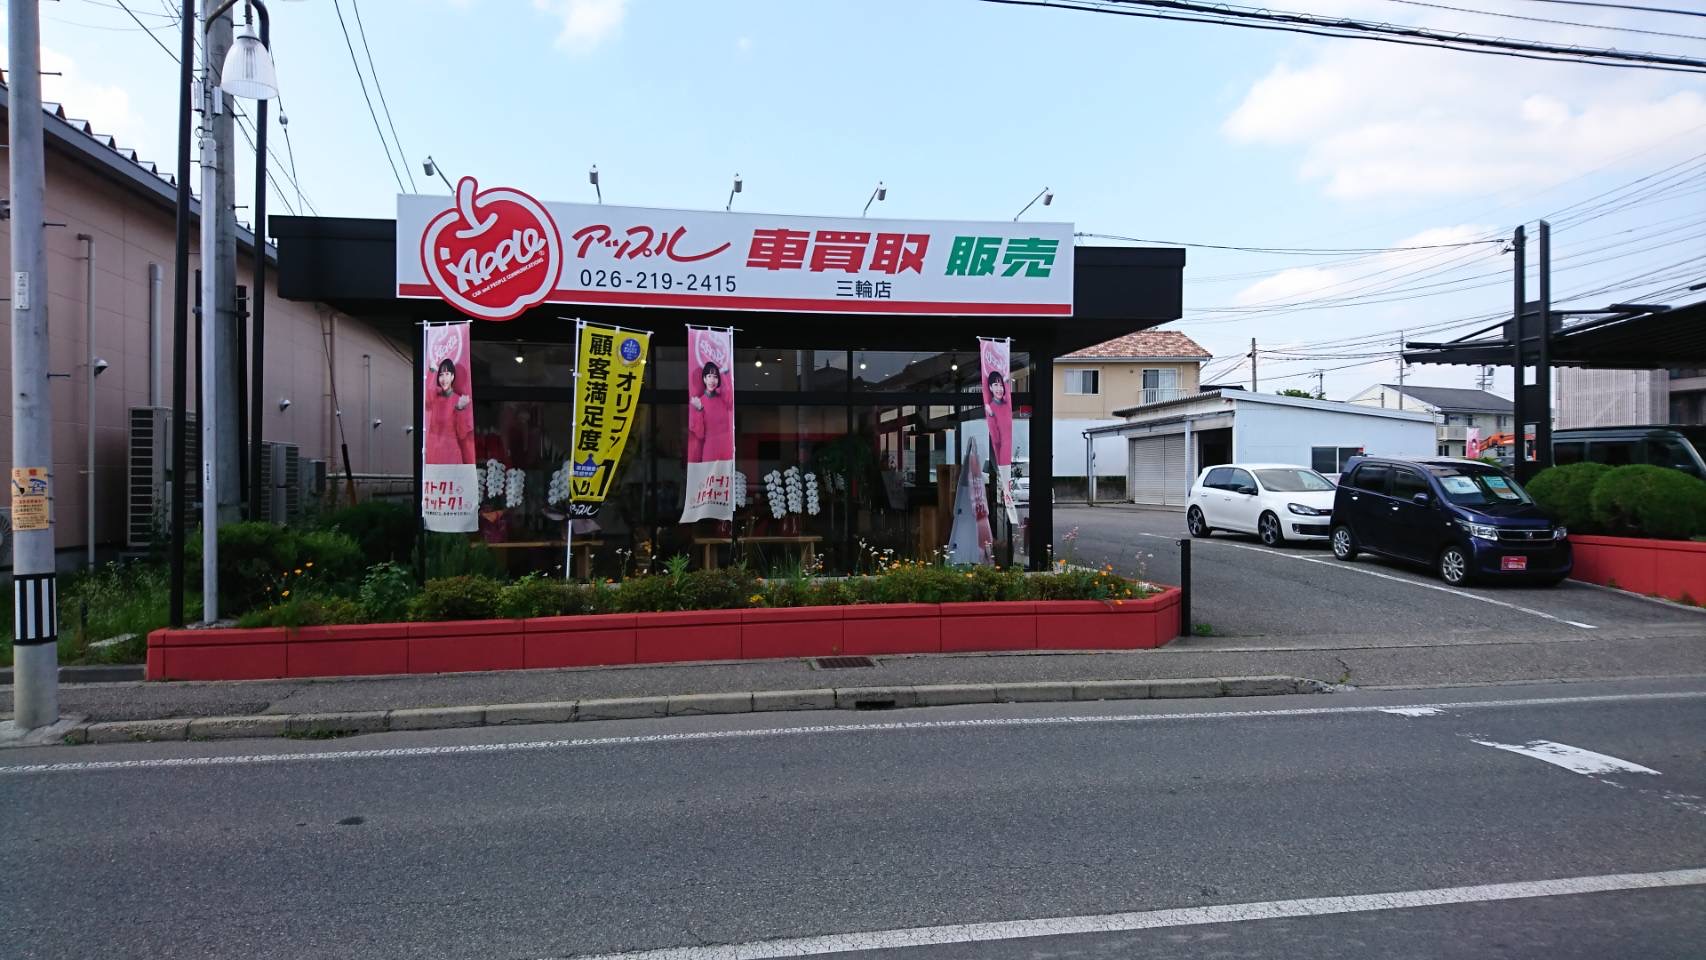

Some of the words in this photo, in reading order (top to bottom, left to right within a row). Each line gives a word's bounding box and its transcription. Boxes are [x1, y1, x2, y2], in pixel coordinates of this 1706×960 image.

[440, 228, 546, 293] Apple
[572, 225, 731, 262] アップル
[746, 229, 930, 275] 車買取
[944, 236, 1060, 278] 販売
[580, 270, 737, 293] 026-219-2415
[836, 280, 892, 299] 三輪店
[577, 333, 613, 453] 顧客満足度
